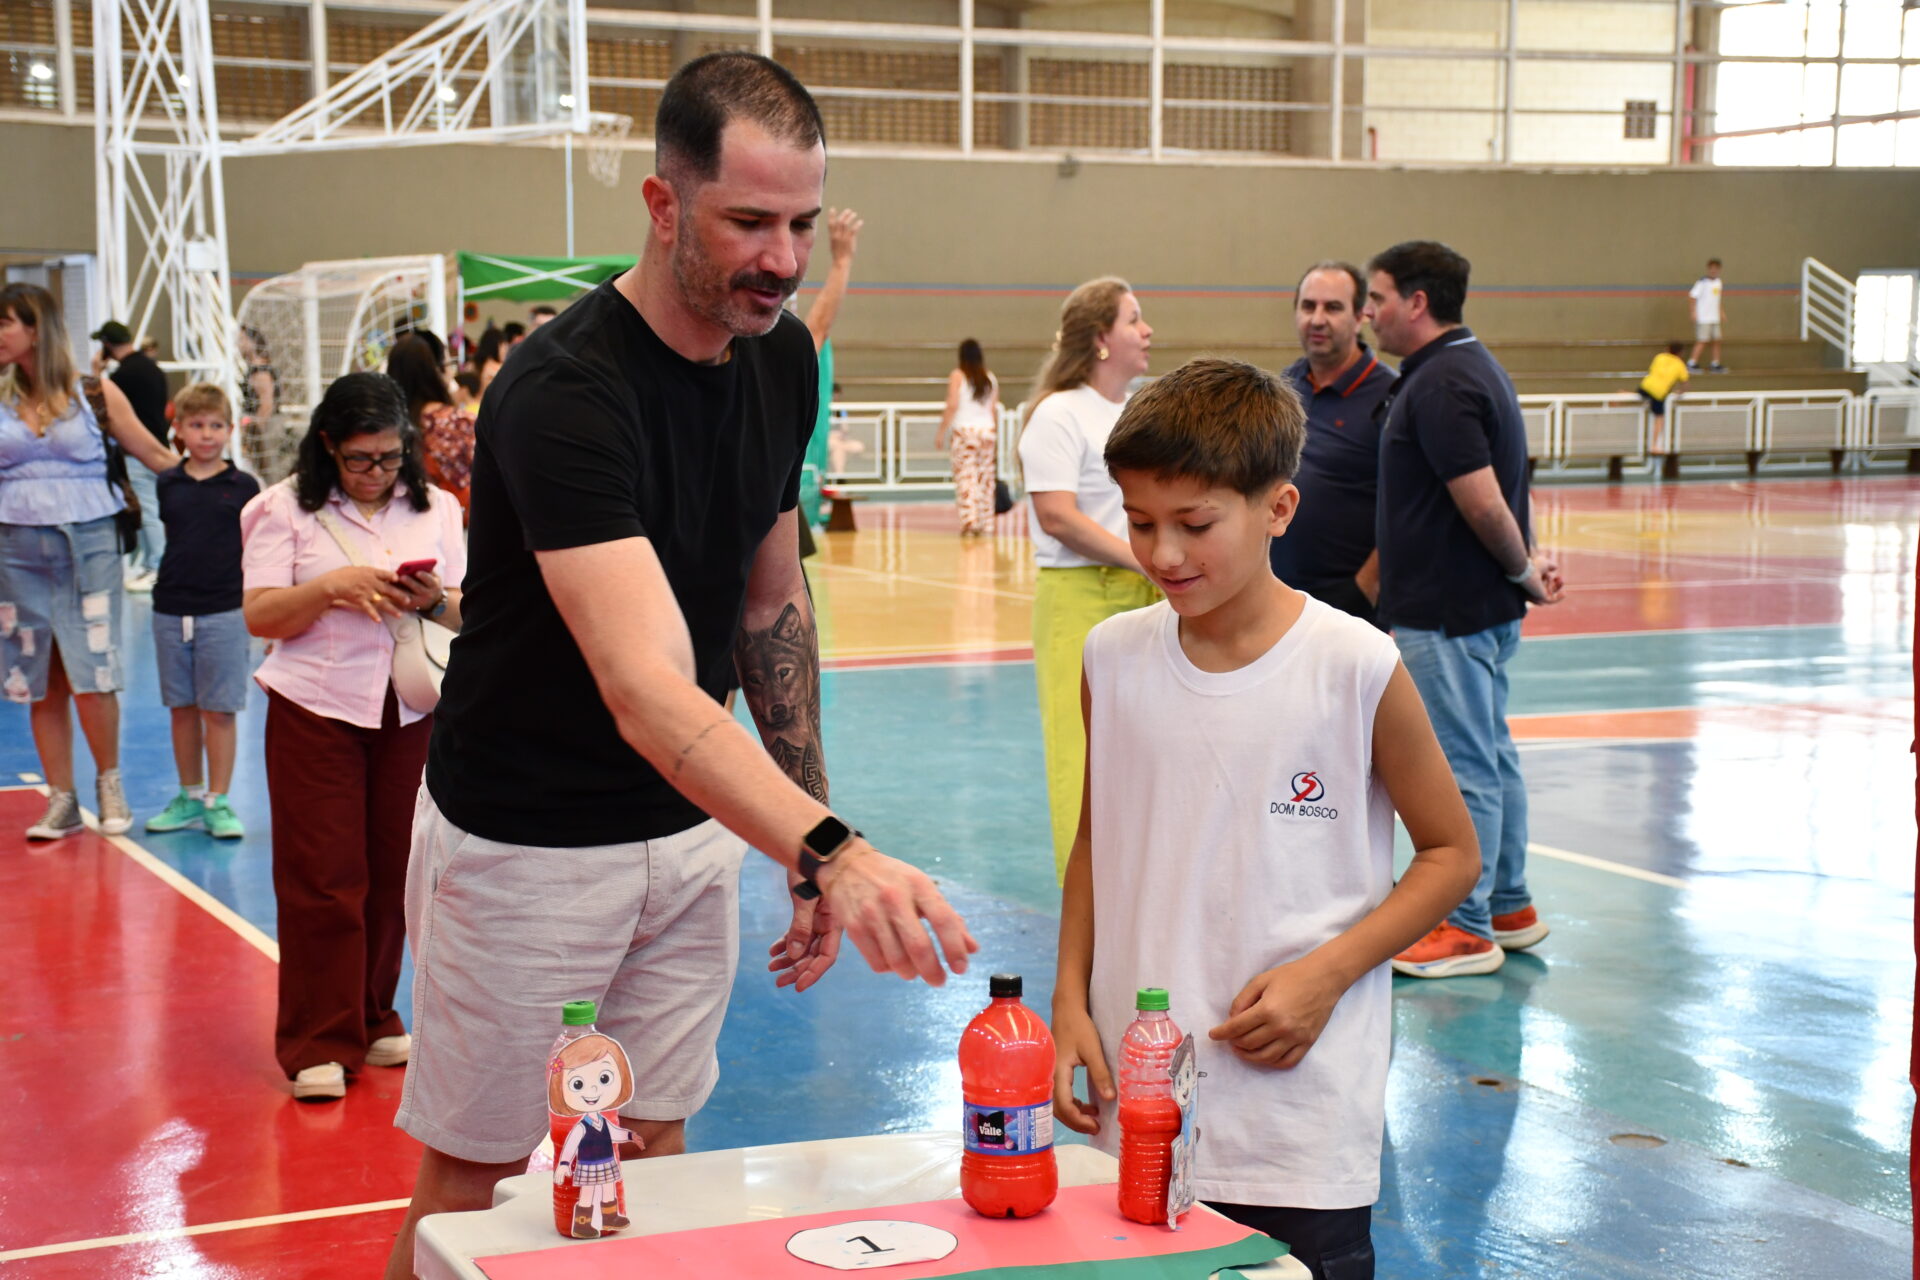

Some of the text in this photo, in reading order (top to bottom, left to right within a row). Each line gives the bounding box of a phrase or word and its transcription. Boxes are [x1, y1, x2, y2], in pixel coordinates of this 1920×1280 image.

[1270, 802, 1338, 820] DOM BOSCO
[978, 1126, 1002, 1137] Valle
[846, 1236, 896, 1255] 1
